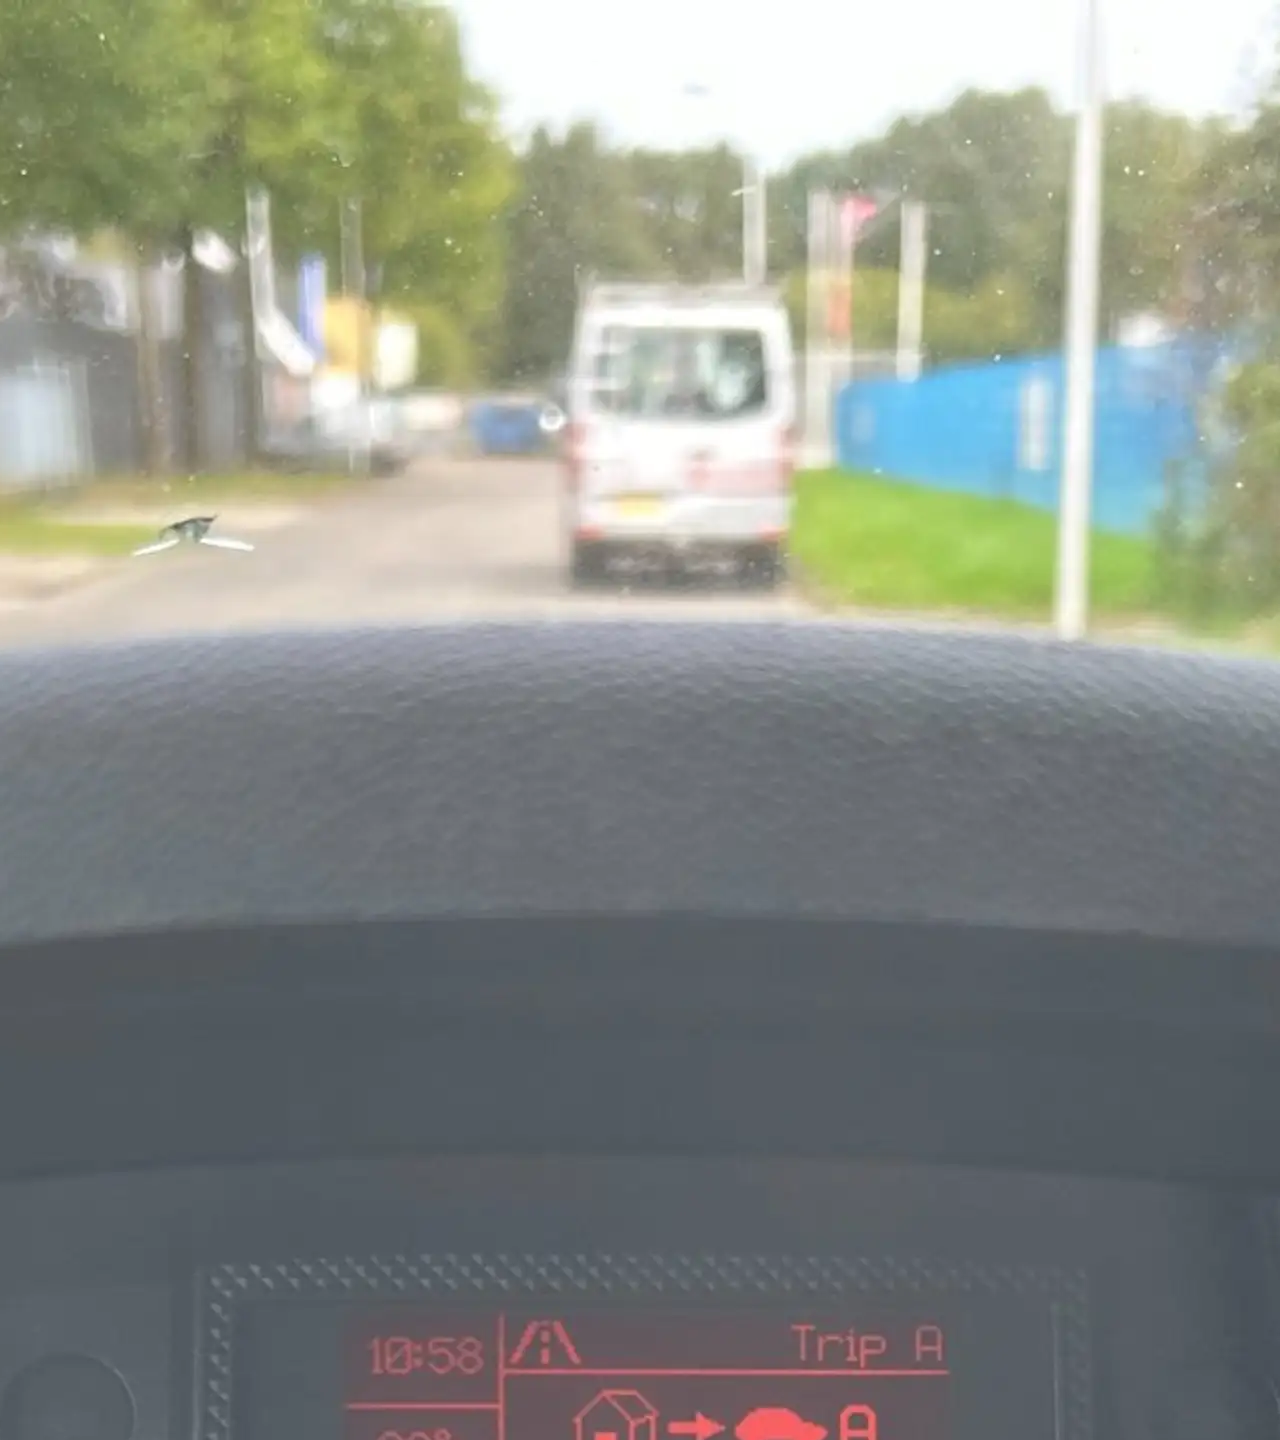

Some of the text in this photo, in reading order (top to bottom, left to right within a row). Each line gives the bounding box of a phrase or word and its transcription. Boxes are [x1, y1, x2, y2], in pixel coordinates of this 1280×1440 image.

[371, 1336, 485, 1375] 10:58
[791, 1324, 943, 1369] Trip A
